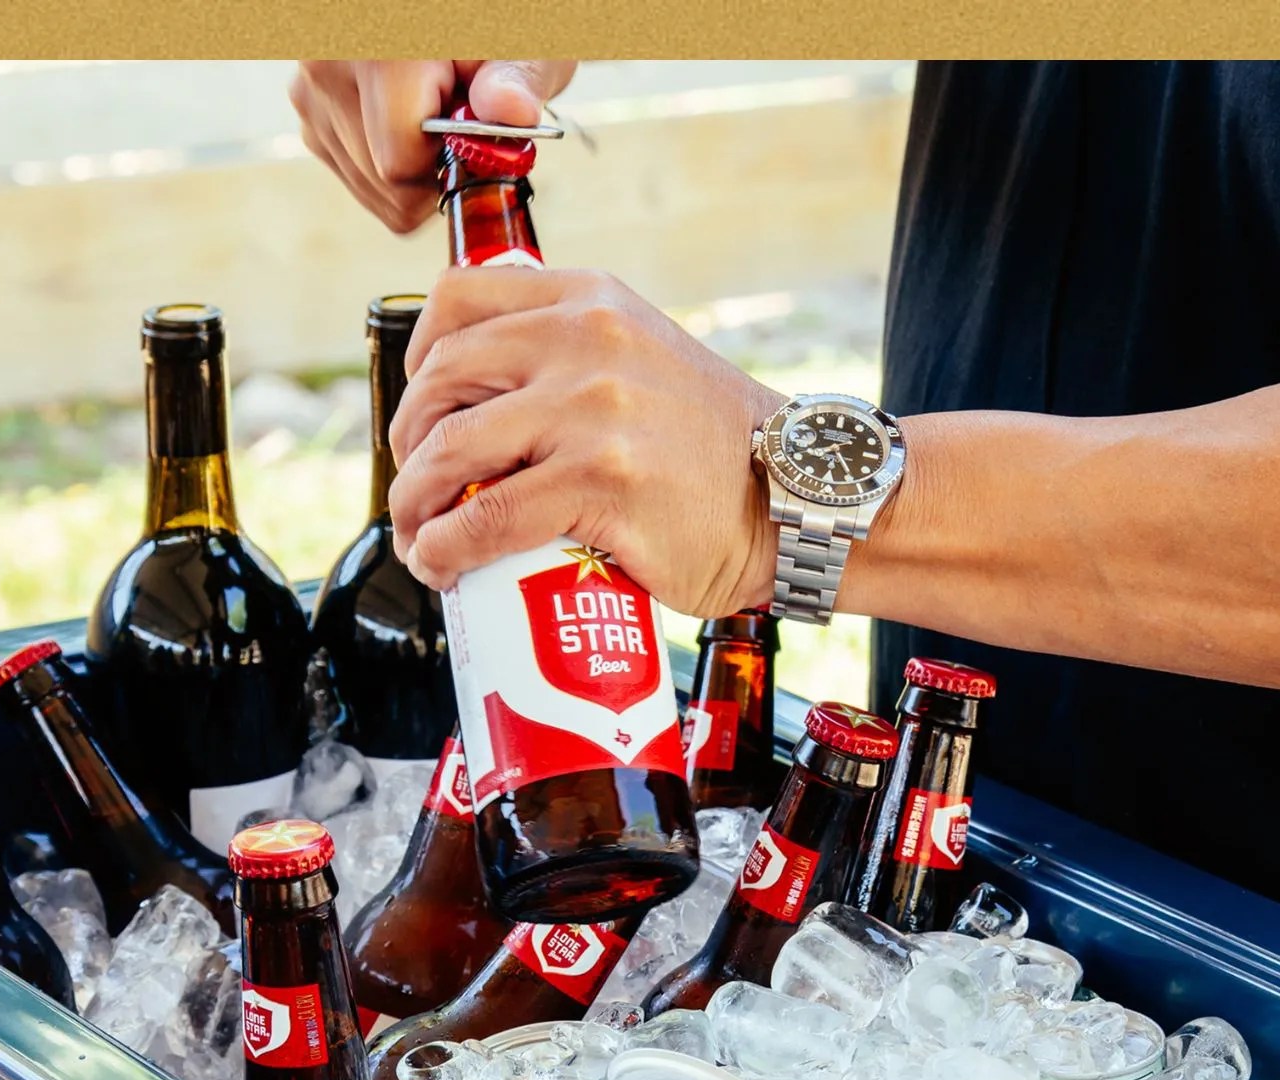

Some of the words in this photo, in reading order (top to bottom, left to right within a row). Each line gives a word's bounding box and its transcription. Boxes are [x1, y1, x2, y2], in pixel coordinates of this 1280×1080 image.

[553, 591, 639, 622] LONE
[559, 623, 649, 656] STAR
[587, 653, 631, 677] Beer
[547, 937, 575, 962] STAR
[553, 928, 581, 953] LONE
[245, 1009, 266, 1025] LONE
[246, 1020, 267, 1037] STAR
